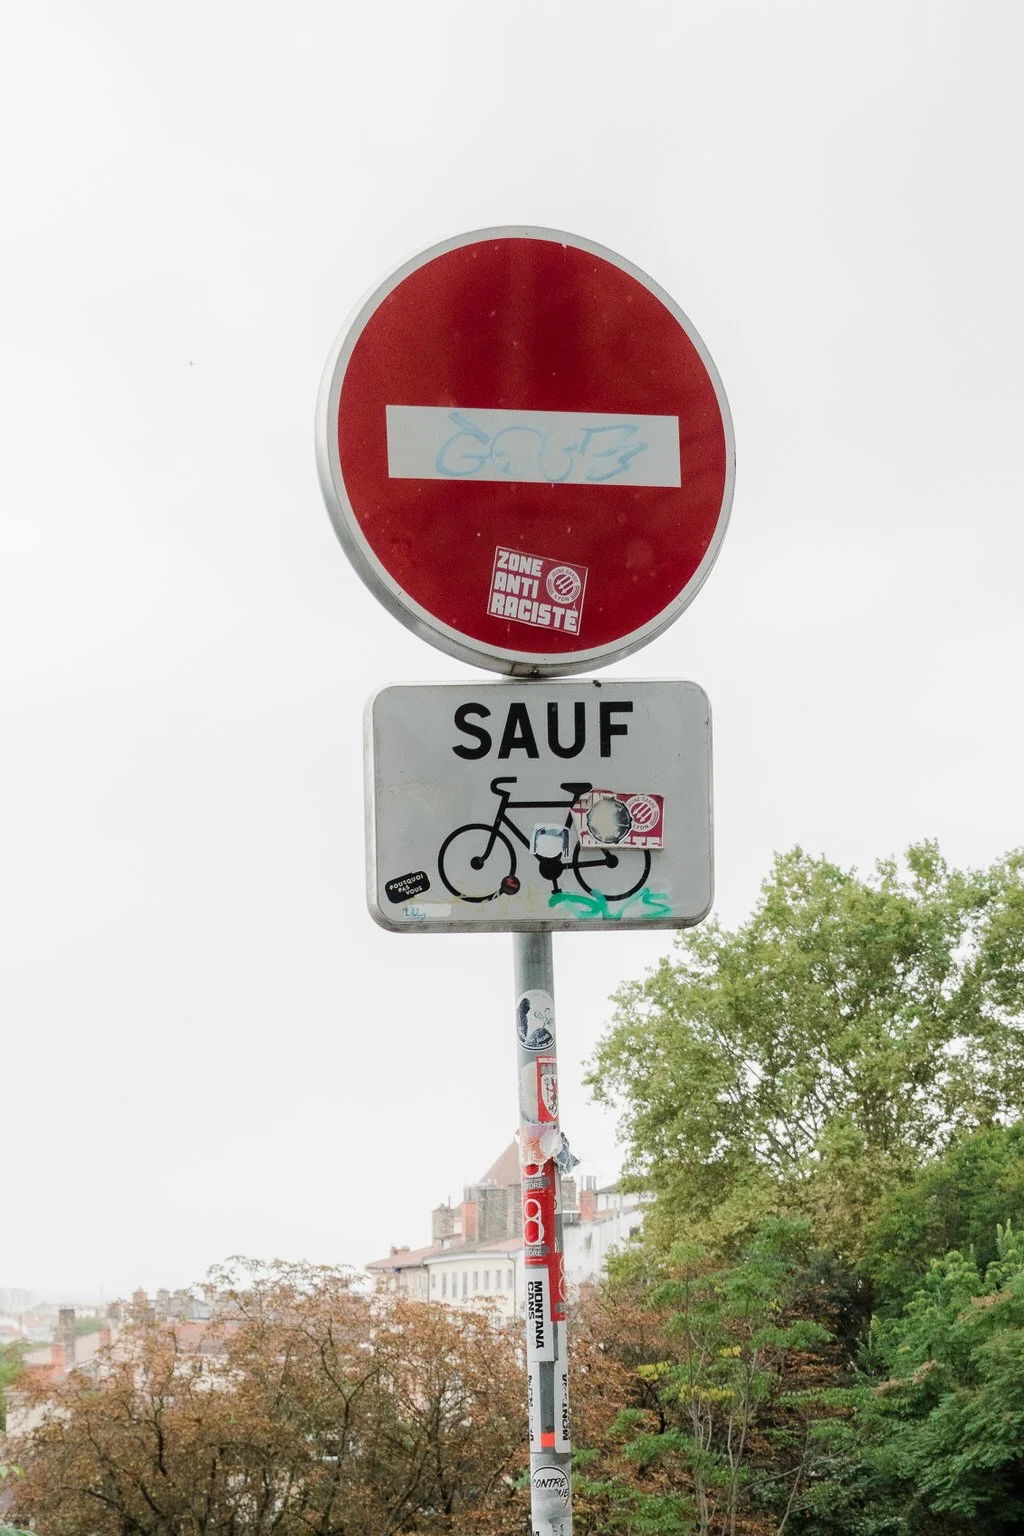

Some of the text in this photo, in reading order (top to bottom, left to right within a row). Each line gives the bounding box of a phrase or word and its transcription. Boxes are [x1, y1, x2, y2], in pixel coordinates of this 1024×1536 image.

[497, 550, 543, 578] ZONE
[493, 571, 539, 599] ANTI
[554, 594, 570, 602] LYON
[490, 592, 578, 632] RACISTE
[451, 700, 634, 761] SAUF
[389, 873, 424, 890] POURQUOI
[397, 884, 410, 893] PAS
[405, 885, 423, 895] VOUS
[534, 1280, 545, 1349] MONTANA
